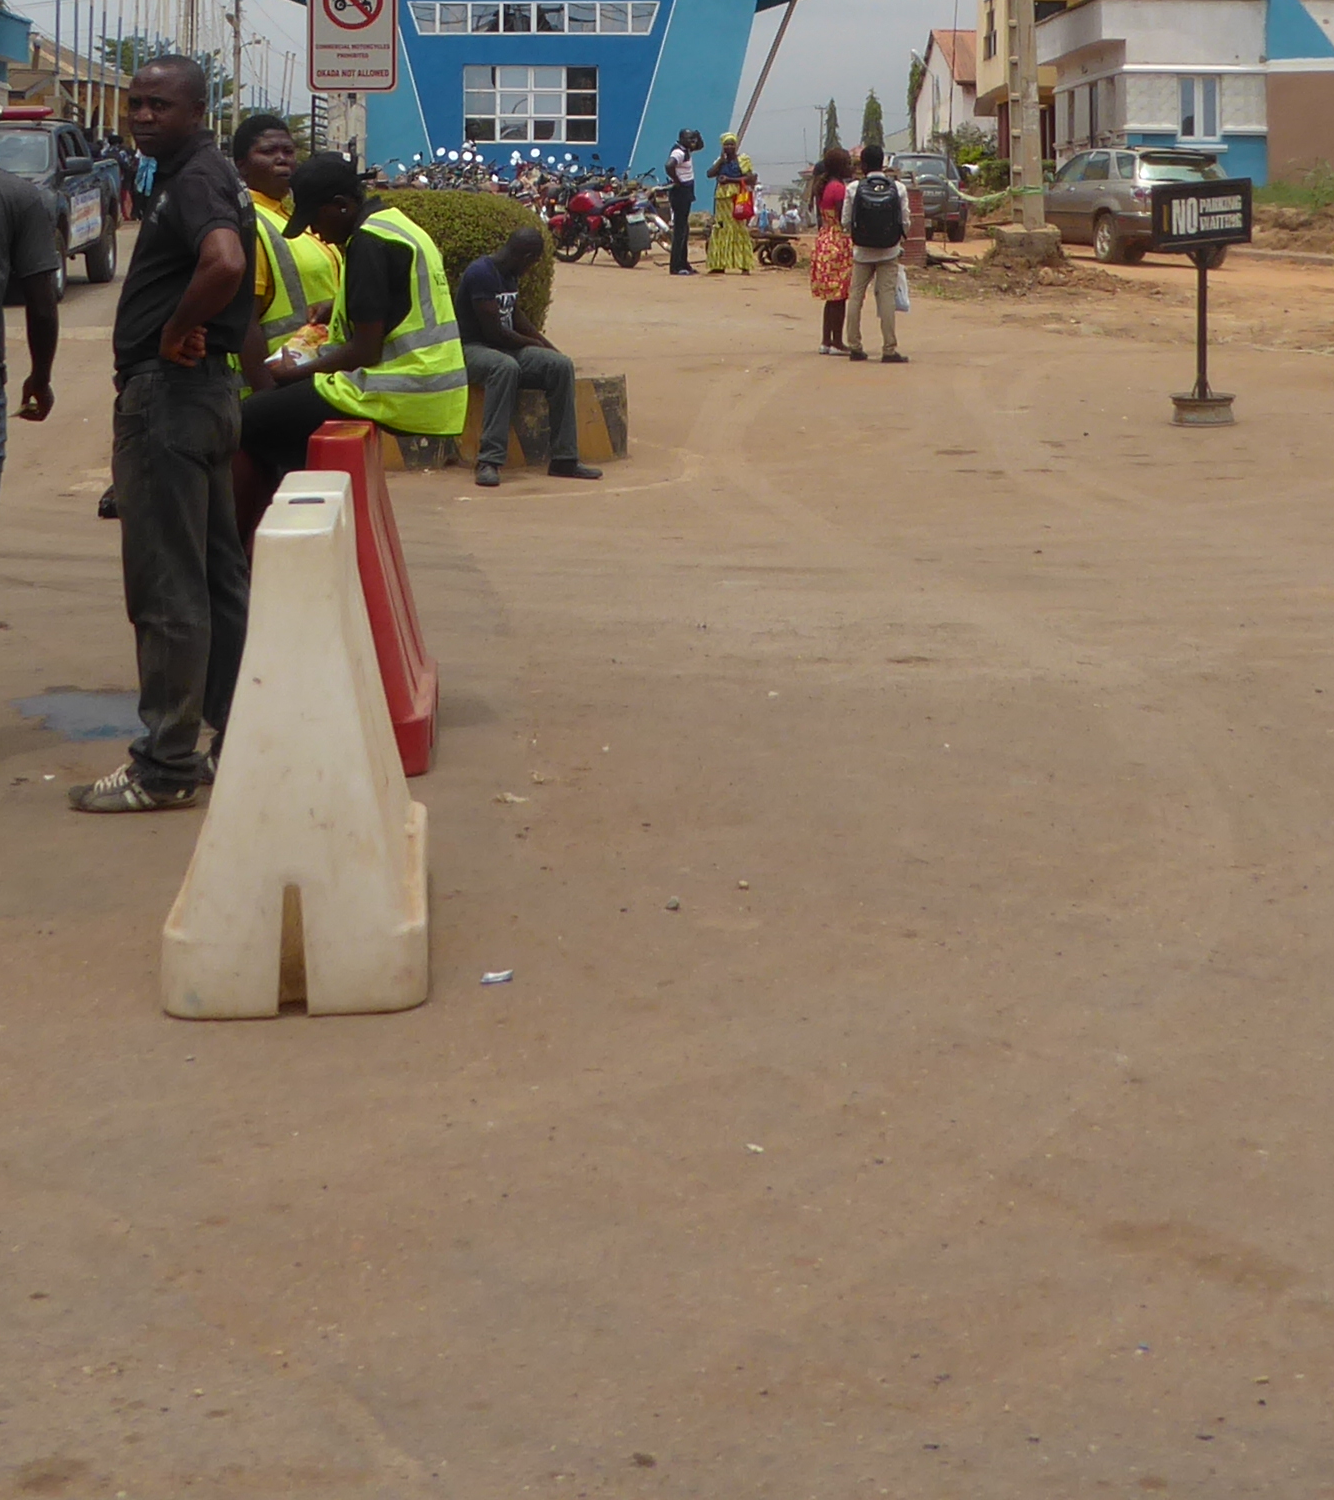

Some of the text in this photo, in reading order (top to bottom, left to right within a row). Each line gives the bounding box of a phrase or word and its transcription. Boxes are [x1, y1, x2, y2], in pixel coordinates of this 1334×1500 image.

[316, 69, 390, 78] OKADA NOT ALLOWED
[1171, 194, 1243, 235] NO PARKING
